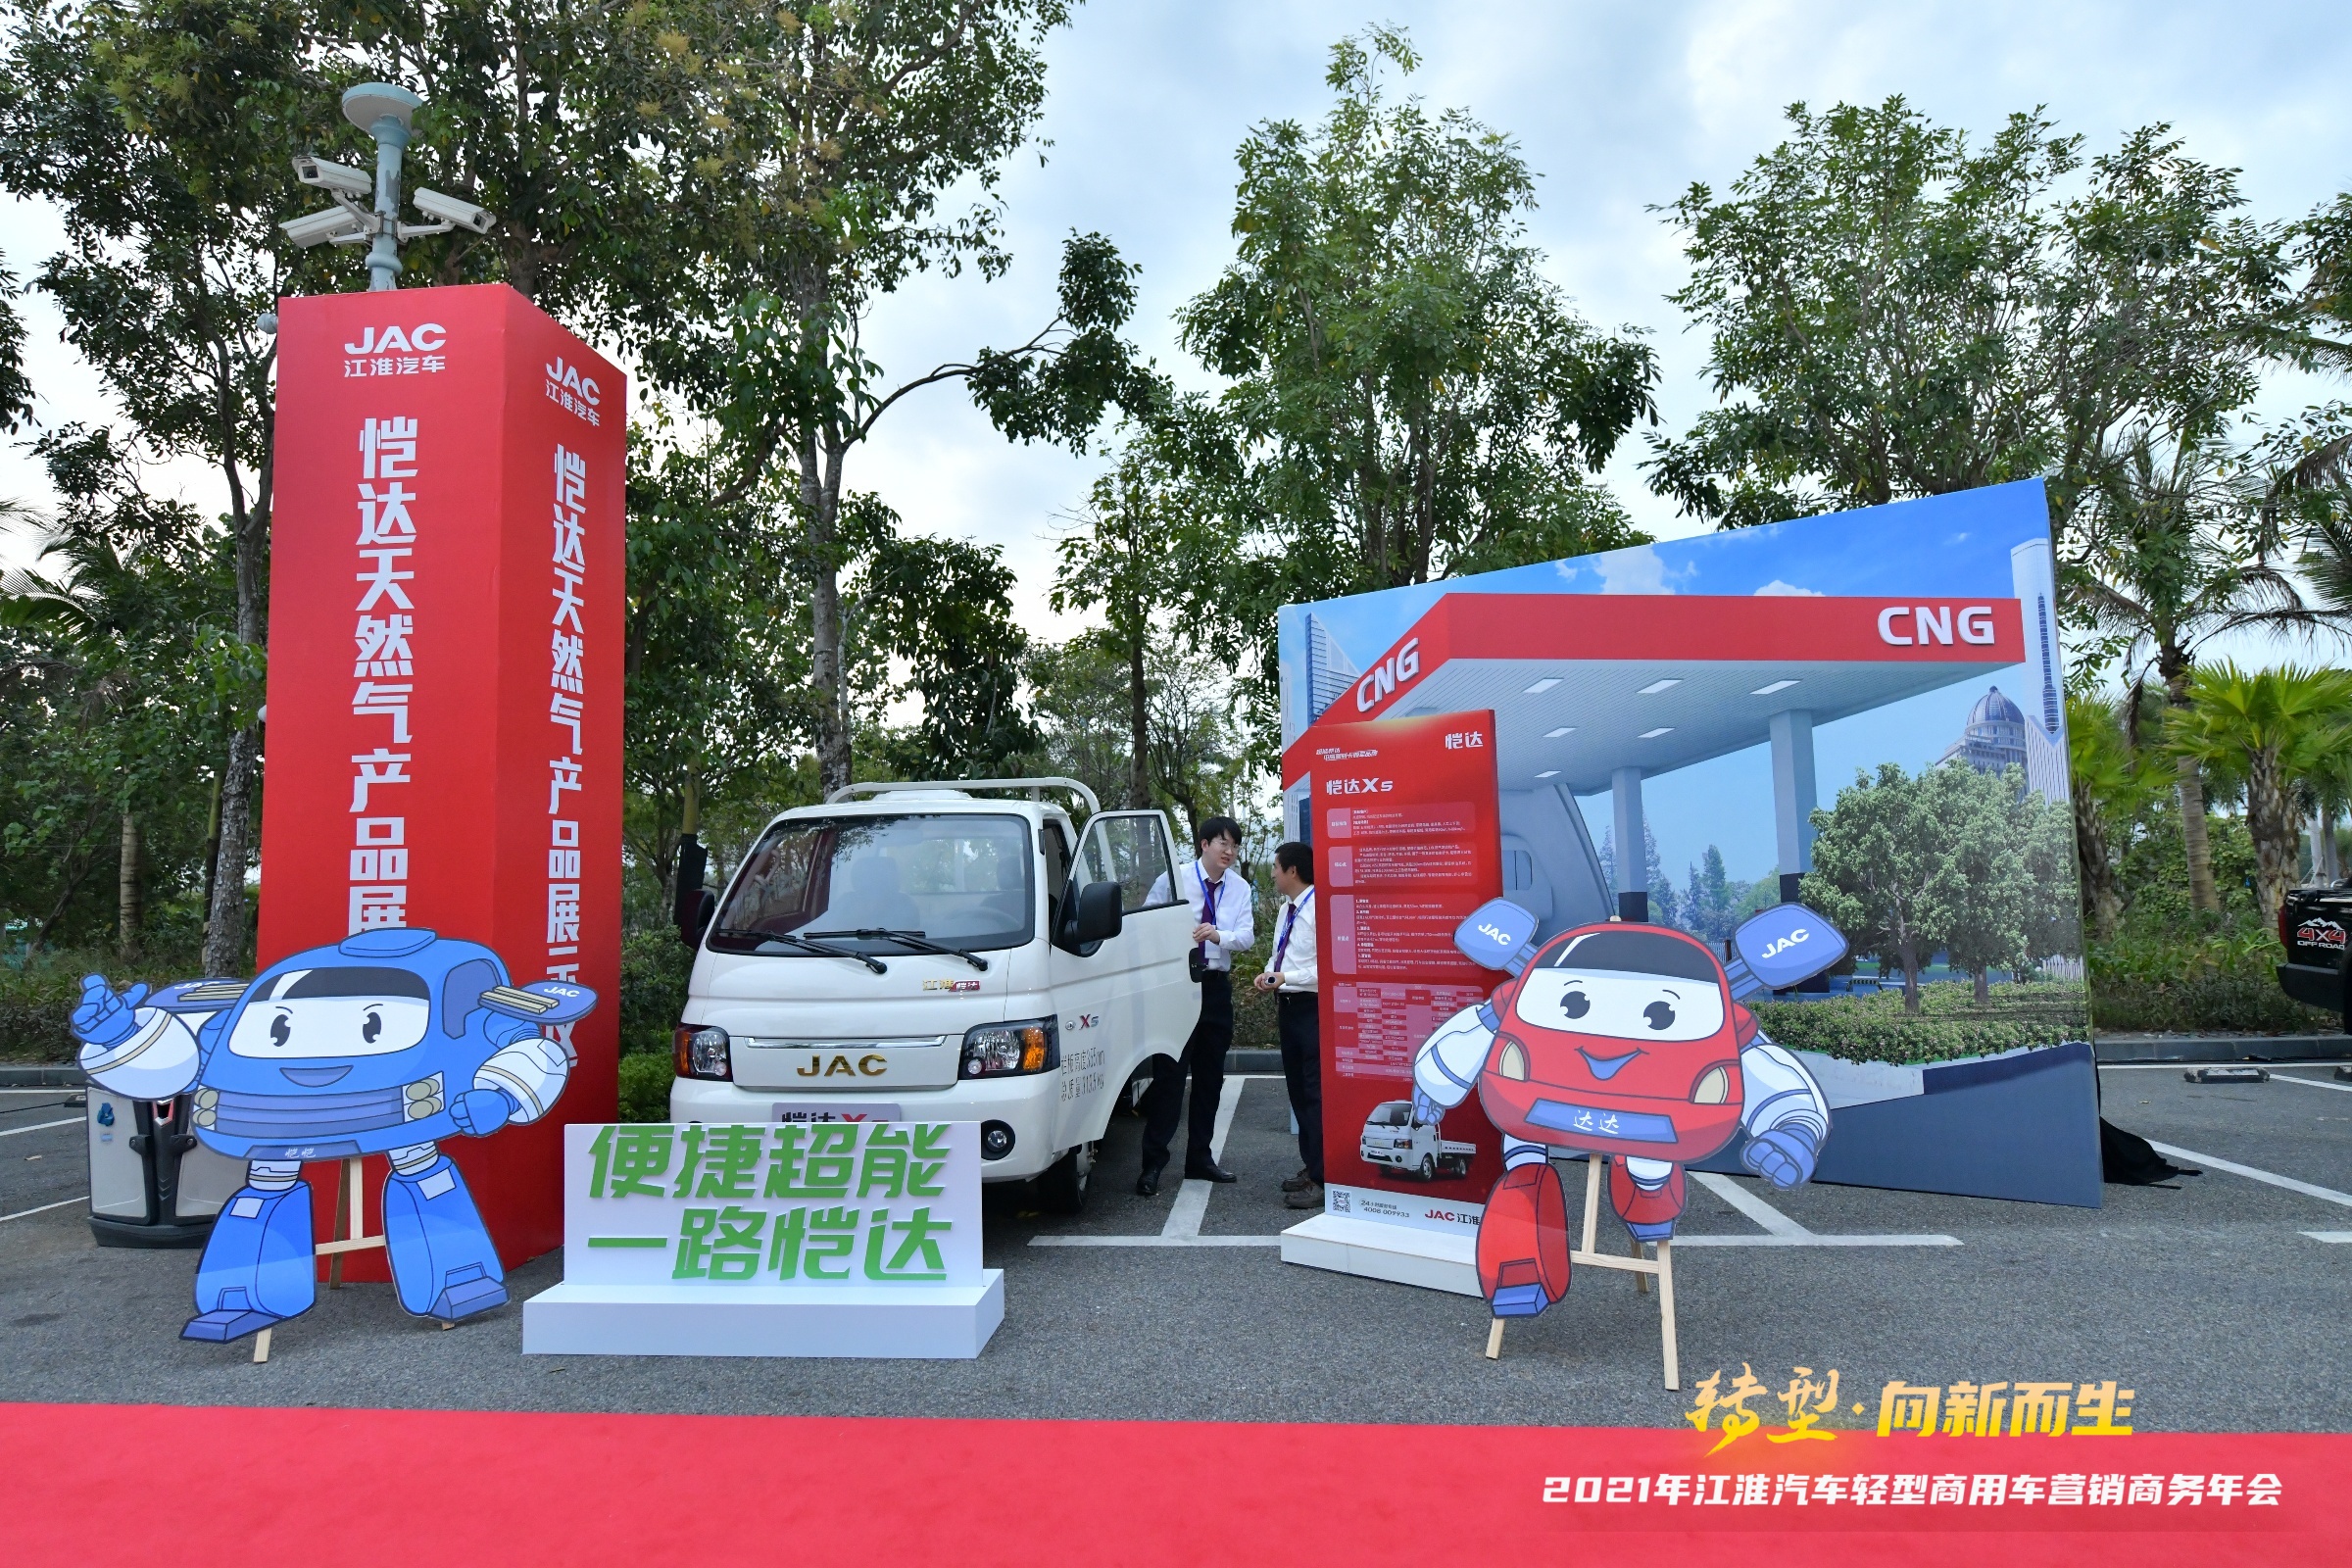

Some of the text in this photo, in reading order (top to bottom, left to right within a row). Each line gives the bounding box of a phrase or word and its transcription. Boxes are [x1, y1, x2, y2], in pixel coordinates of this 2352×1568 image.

[344, 323, 447, 355] JAC
[344, 355, 446, 378] 江淮汽车
[546, 356, 600, 406] JAC
[546, 378, 601, 427] 江淮汽车
[1877, 605, 1995, 647] CNG
[348, 416, 418, 936] 恺达天然气产品展
[1356, 636, 1420, 712] CNG
[1445, 731, 1484, 750] 恺达
[1478, 922, 1511, 946] JAC
[1761, 928, 1810, 959] JAC
[2318, 942, 2346, 951] ROAD
[544, 986, 580, 998] JAC
[797, 1054, 888, 1077] JAC
[1573, 1109, 1620, 1135] 达达
[285, 1147, 317, 1158] 恺恺
[588, 1123, 953, 1200] 便捷超能
[1424, 1208, 1455, 1222] JAC
[588, 1205, 953, 1281] 一路恺达
